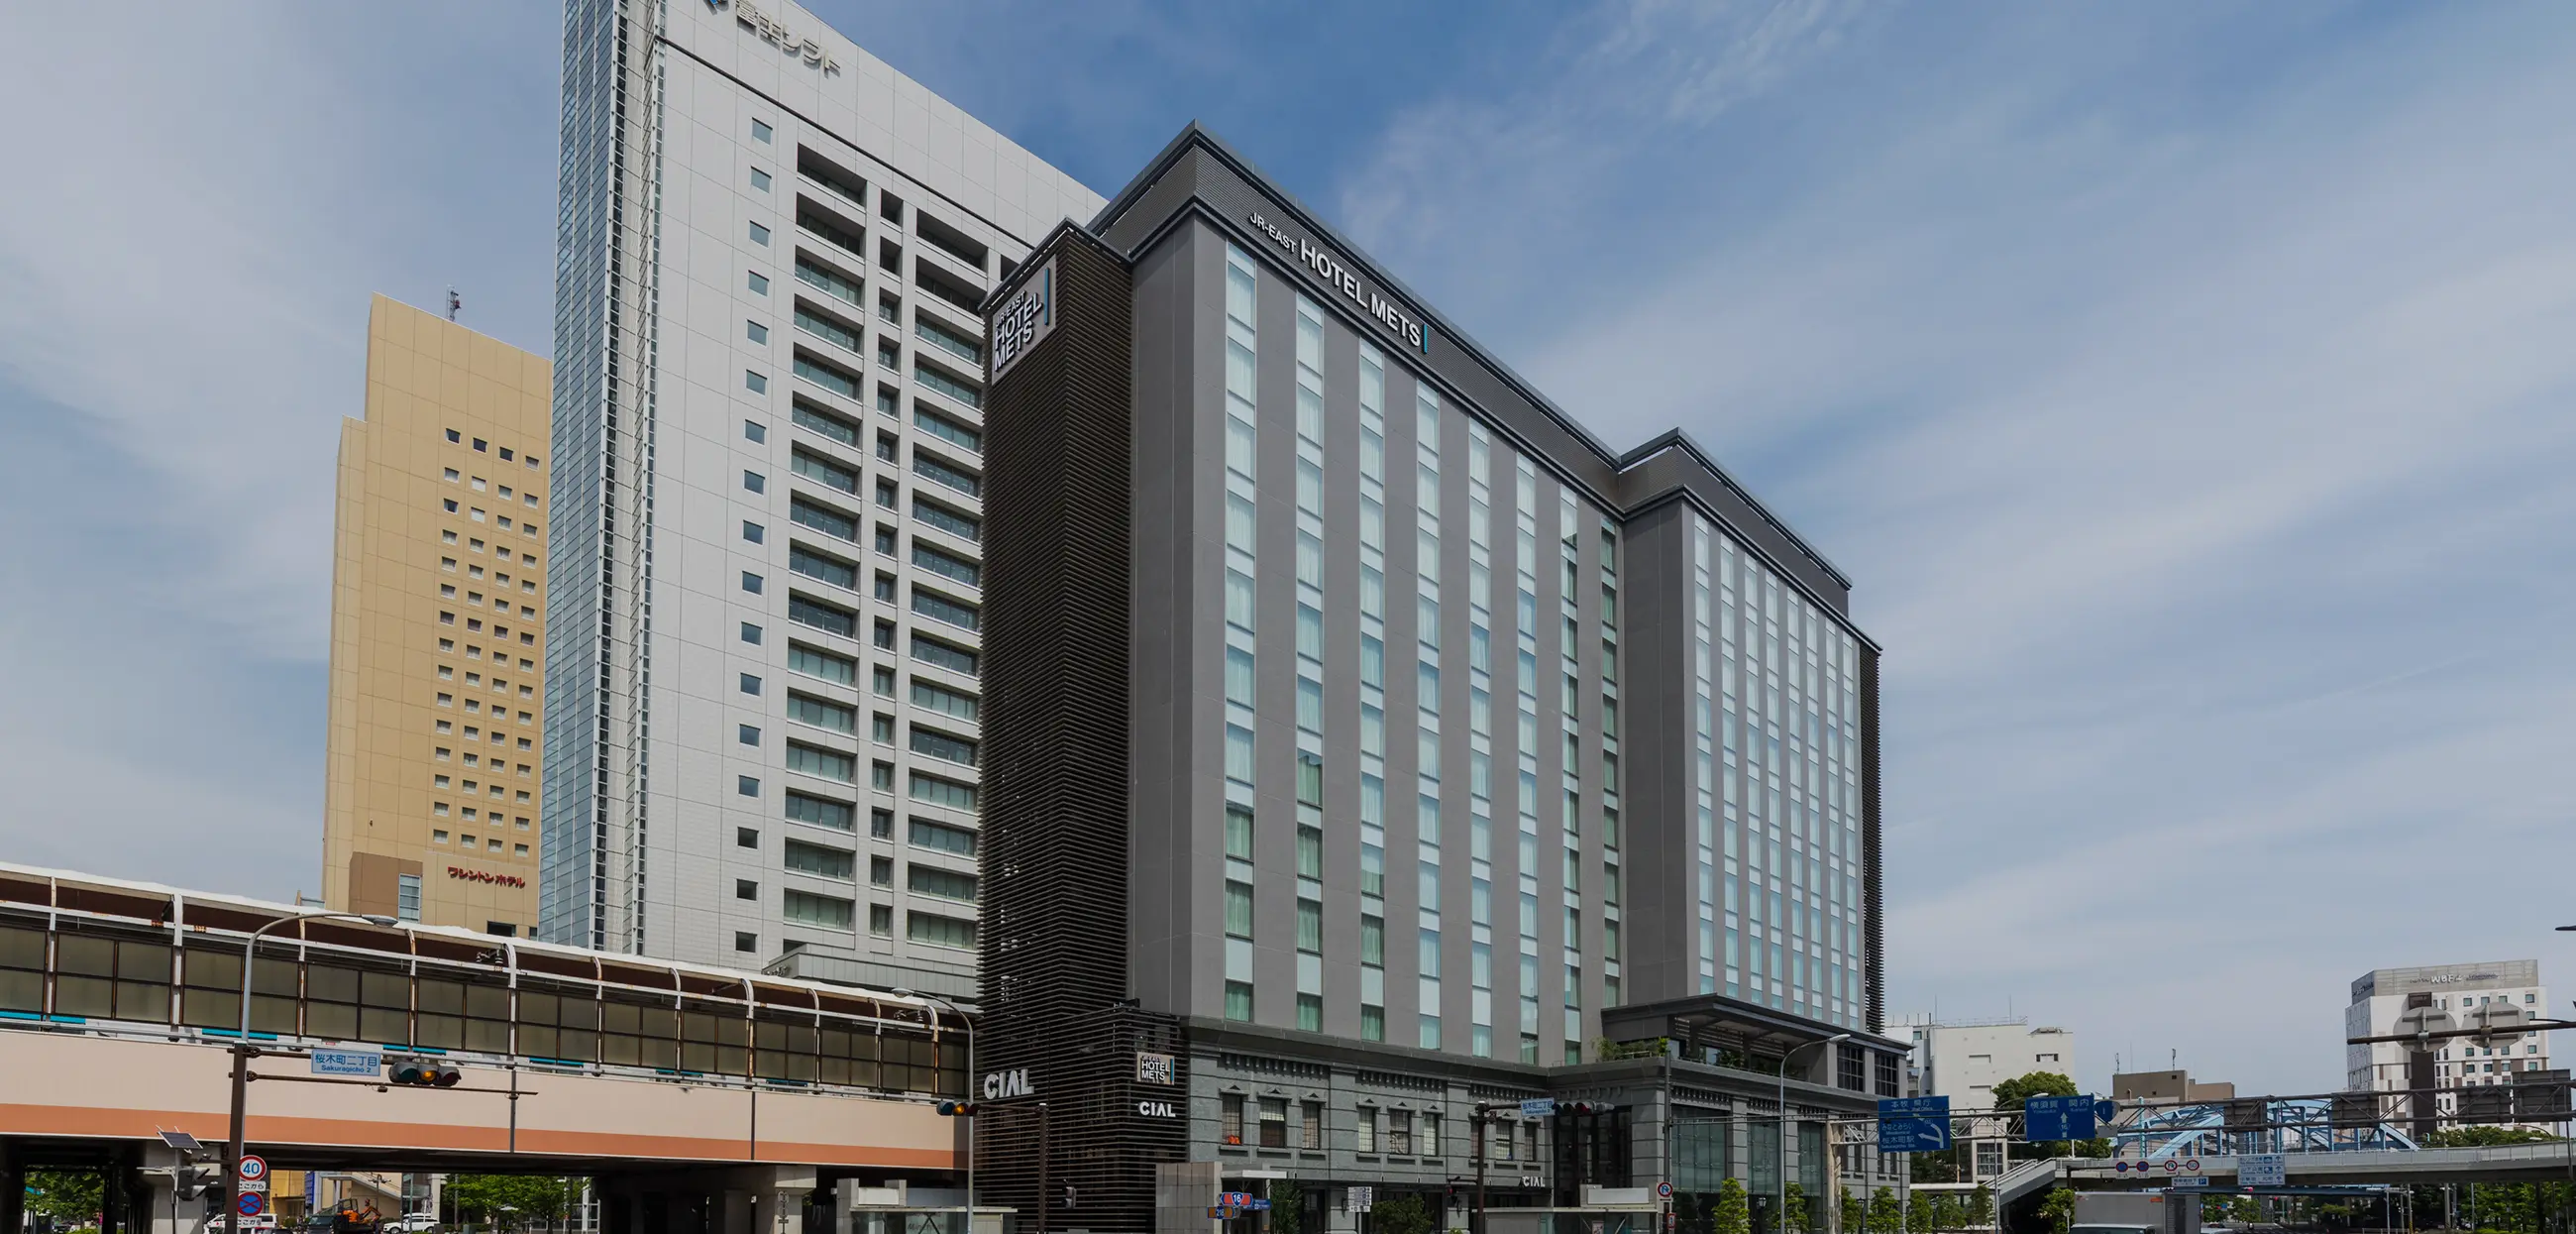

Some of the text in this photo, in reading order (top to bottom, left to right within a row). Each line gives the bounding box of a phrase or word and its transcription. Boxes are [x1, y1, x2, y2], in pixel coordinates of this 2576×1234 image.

[1250, 212, 1421, 347] JR-EAST HOTEL METS
[996, 290, 1026, 327] JR-EAST
[995, 293, 1042, 350] HOTEL
[994, 321, 1032, 372] METS
[315, 1054, 376, 1066] 桜木町二丁目
[1141, 1061, 1170, 1071] HOTEL
[1141, 1069, 1165, 1080] METS
[984, 1068, 1034, 1099] CIAL
[1139, 1101, 1176, 1117] CIAL
[243, 1163, 260, 1174] 40
[1523, 1177, 1545, 1186] CIAL
